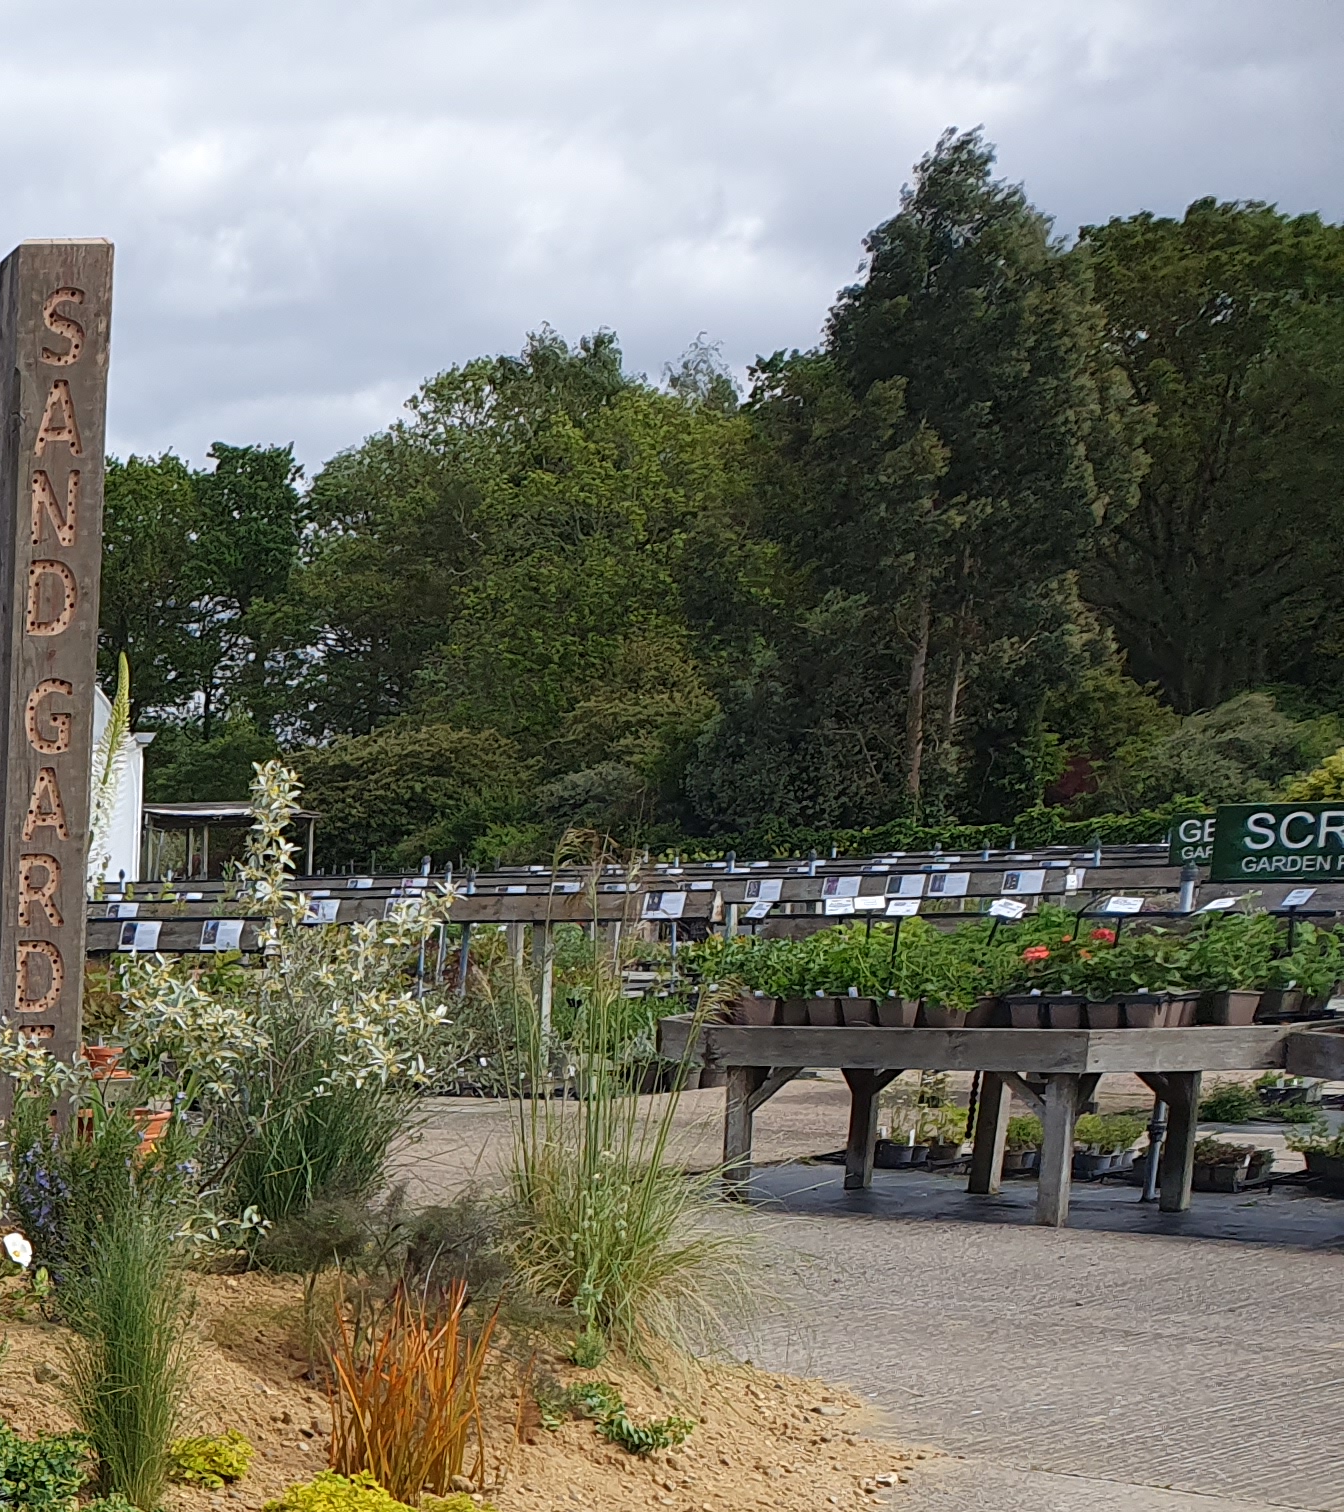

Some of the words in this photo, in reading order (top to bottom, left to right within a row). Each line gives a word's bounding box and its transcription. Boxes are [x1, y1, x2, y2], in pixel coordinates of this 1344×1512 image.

[26, 286, 86, 637] SAND
[14, 677, 74, 1112] GARD
[1241, 855, 1333, 872] GARDEN
